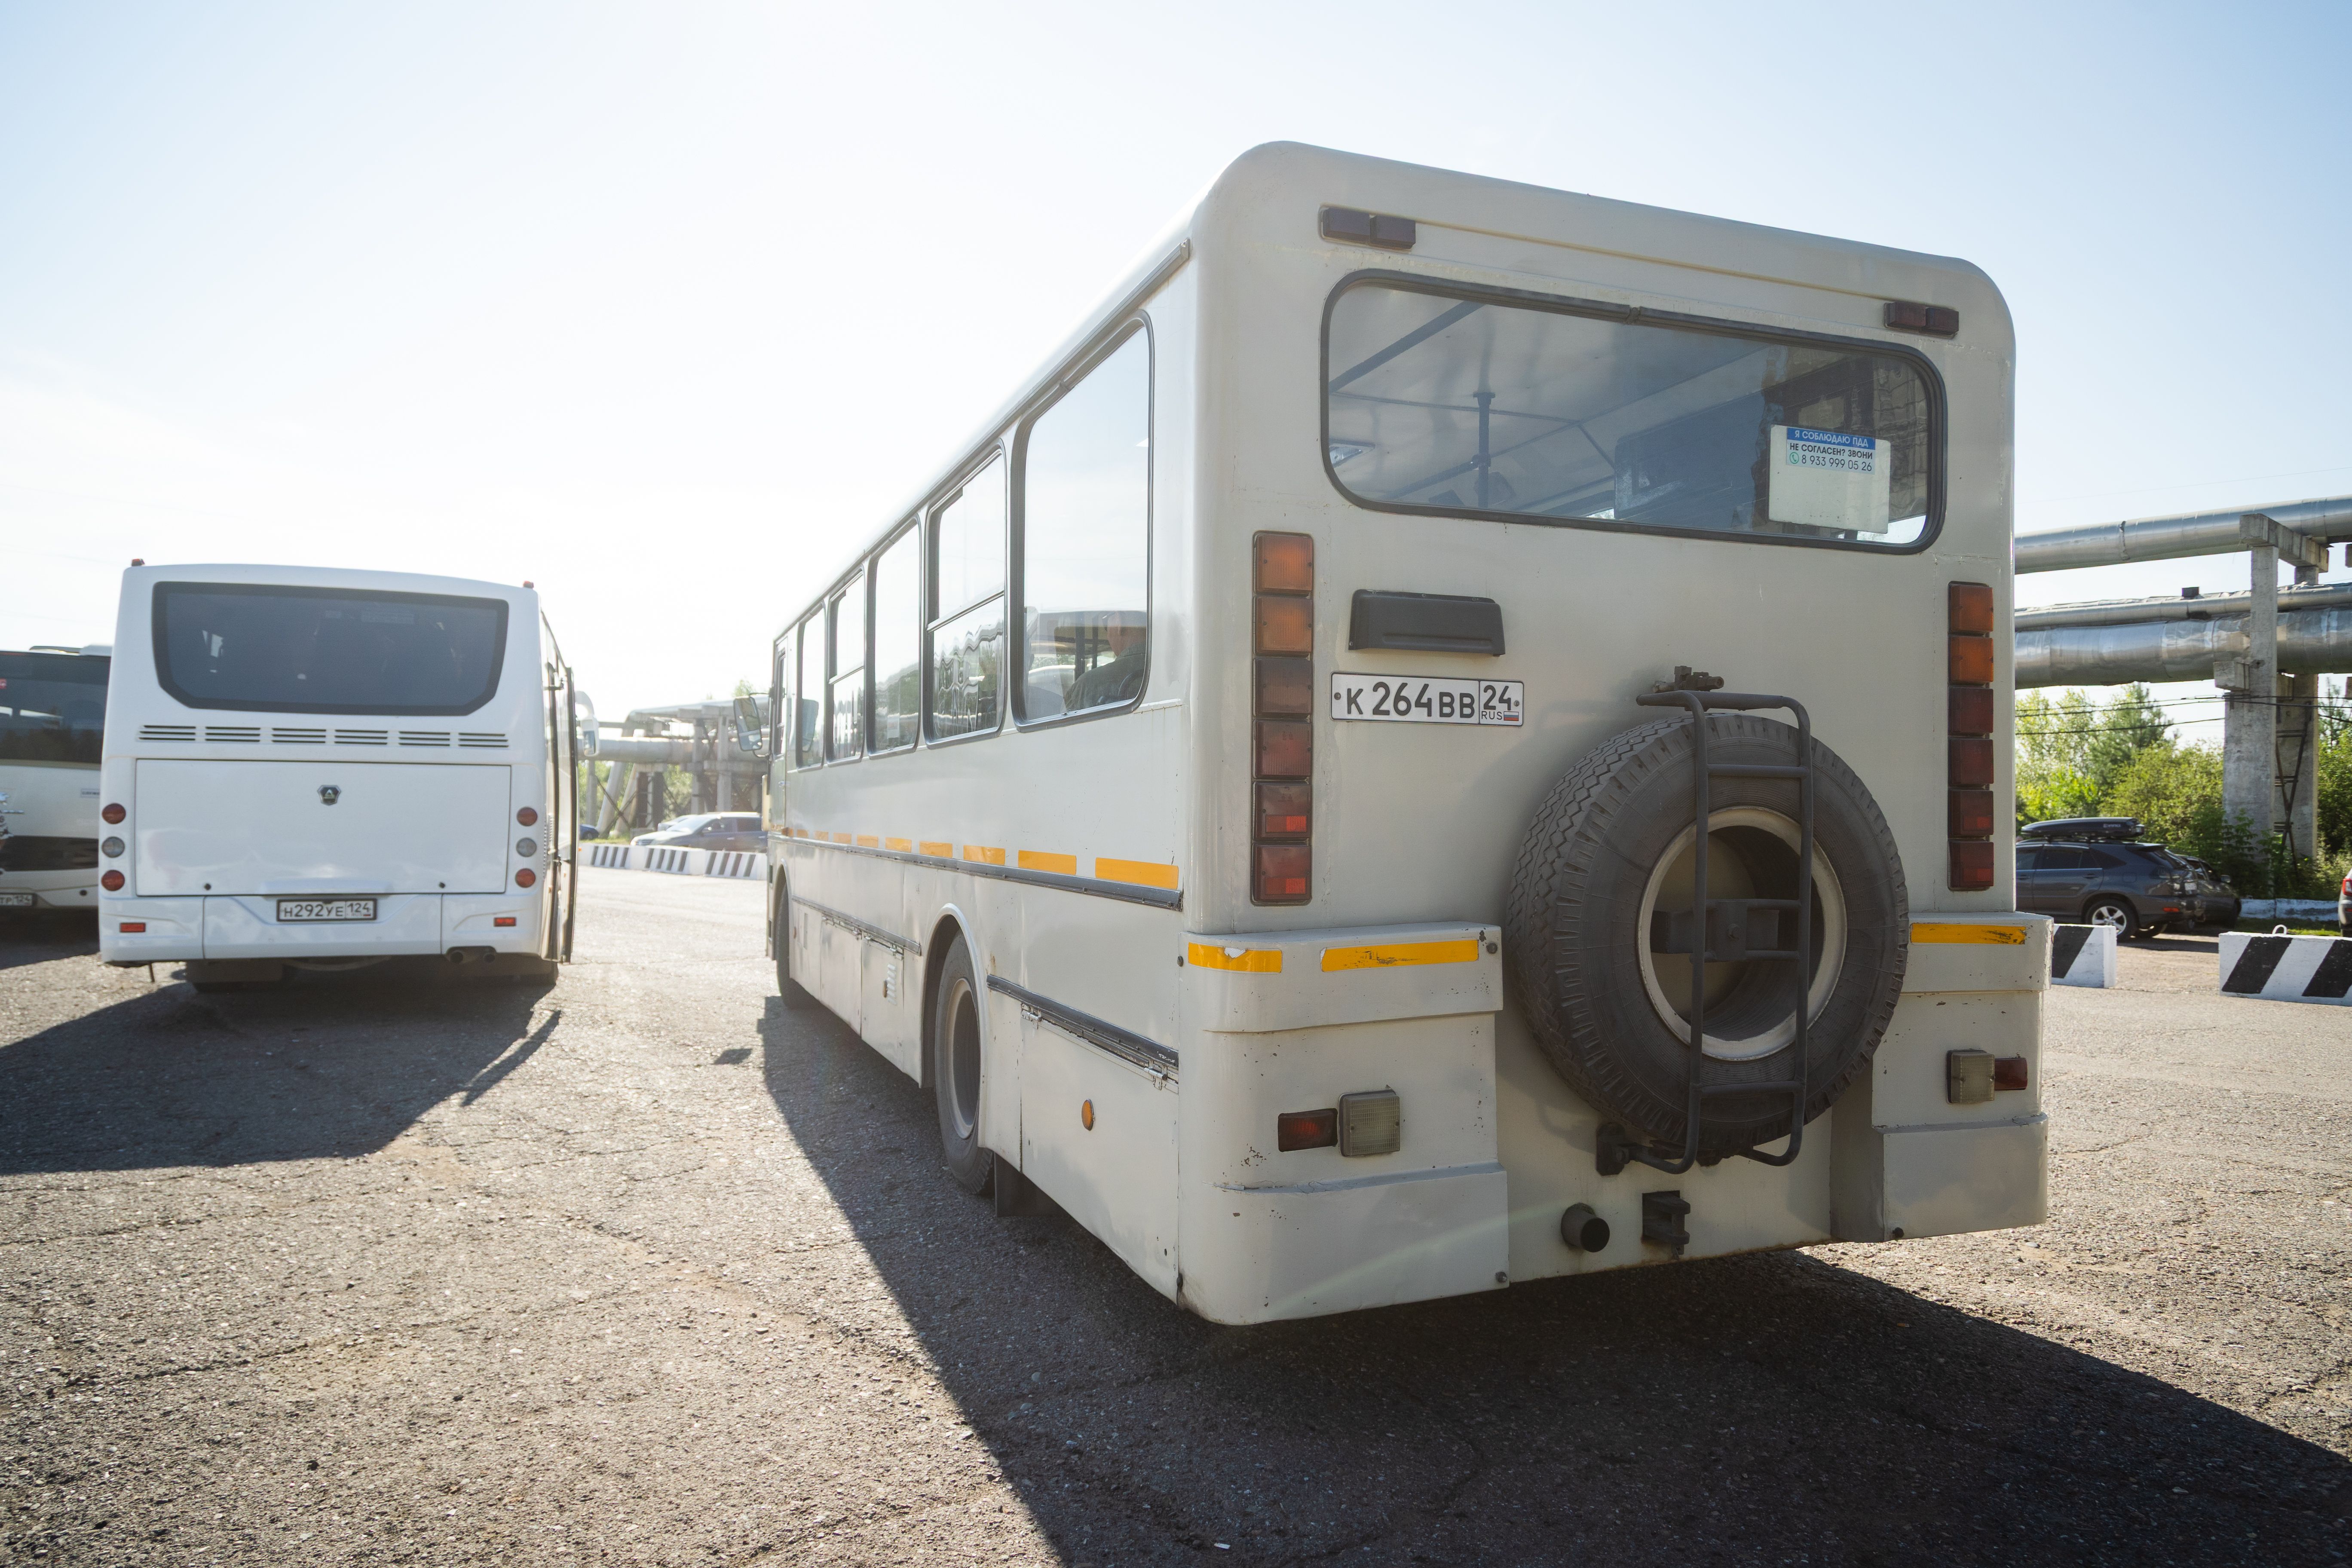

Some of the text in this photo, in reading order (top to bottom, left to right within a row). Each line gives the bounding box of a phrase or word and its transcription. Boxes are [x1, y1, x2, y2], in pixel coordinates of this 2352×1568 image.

[1795, 430, 1868, 447] Я СОБЛЮДАЮ ПДД
[1801, 444, 1845, 456] СОГЛАСЕН?
[1848, 450, 1873, 459] ЗВОНИ
[1801, 454, 1872, 472] 8 933 999 05 26
[1347, 681, 1512, 718] К264ВВ 24
[1481, 710, 1502, 720] RUS
[347, 903, 370, 913] 124
